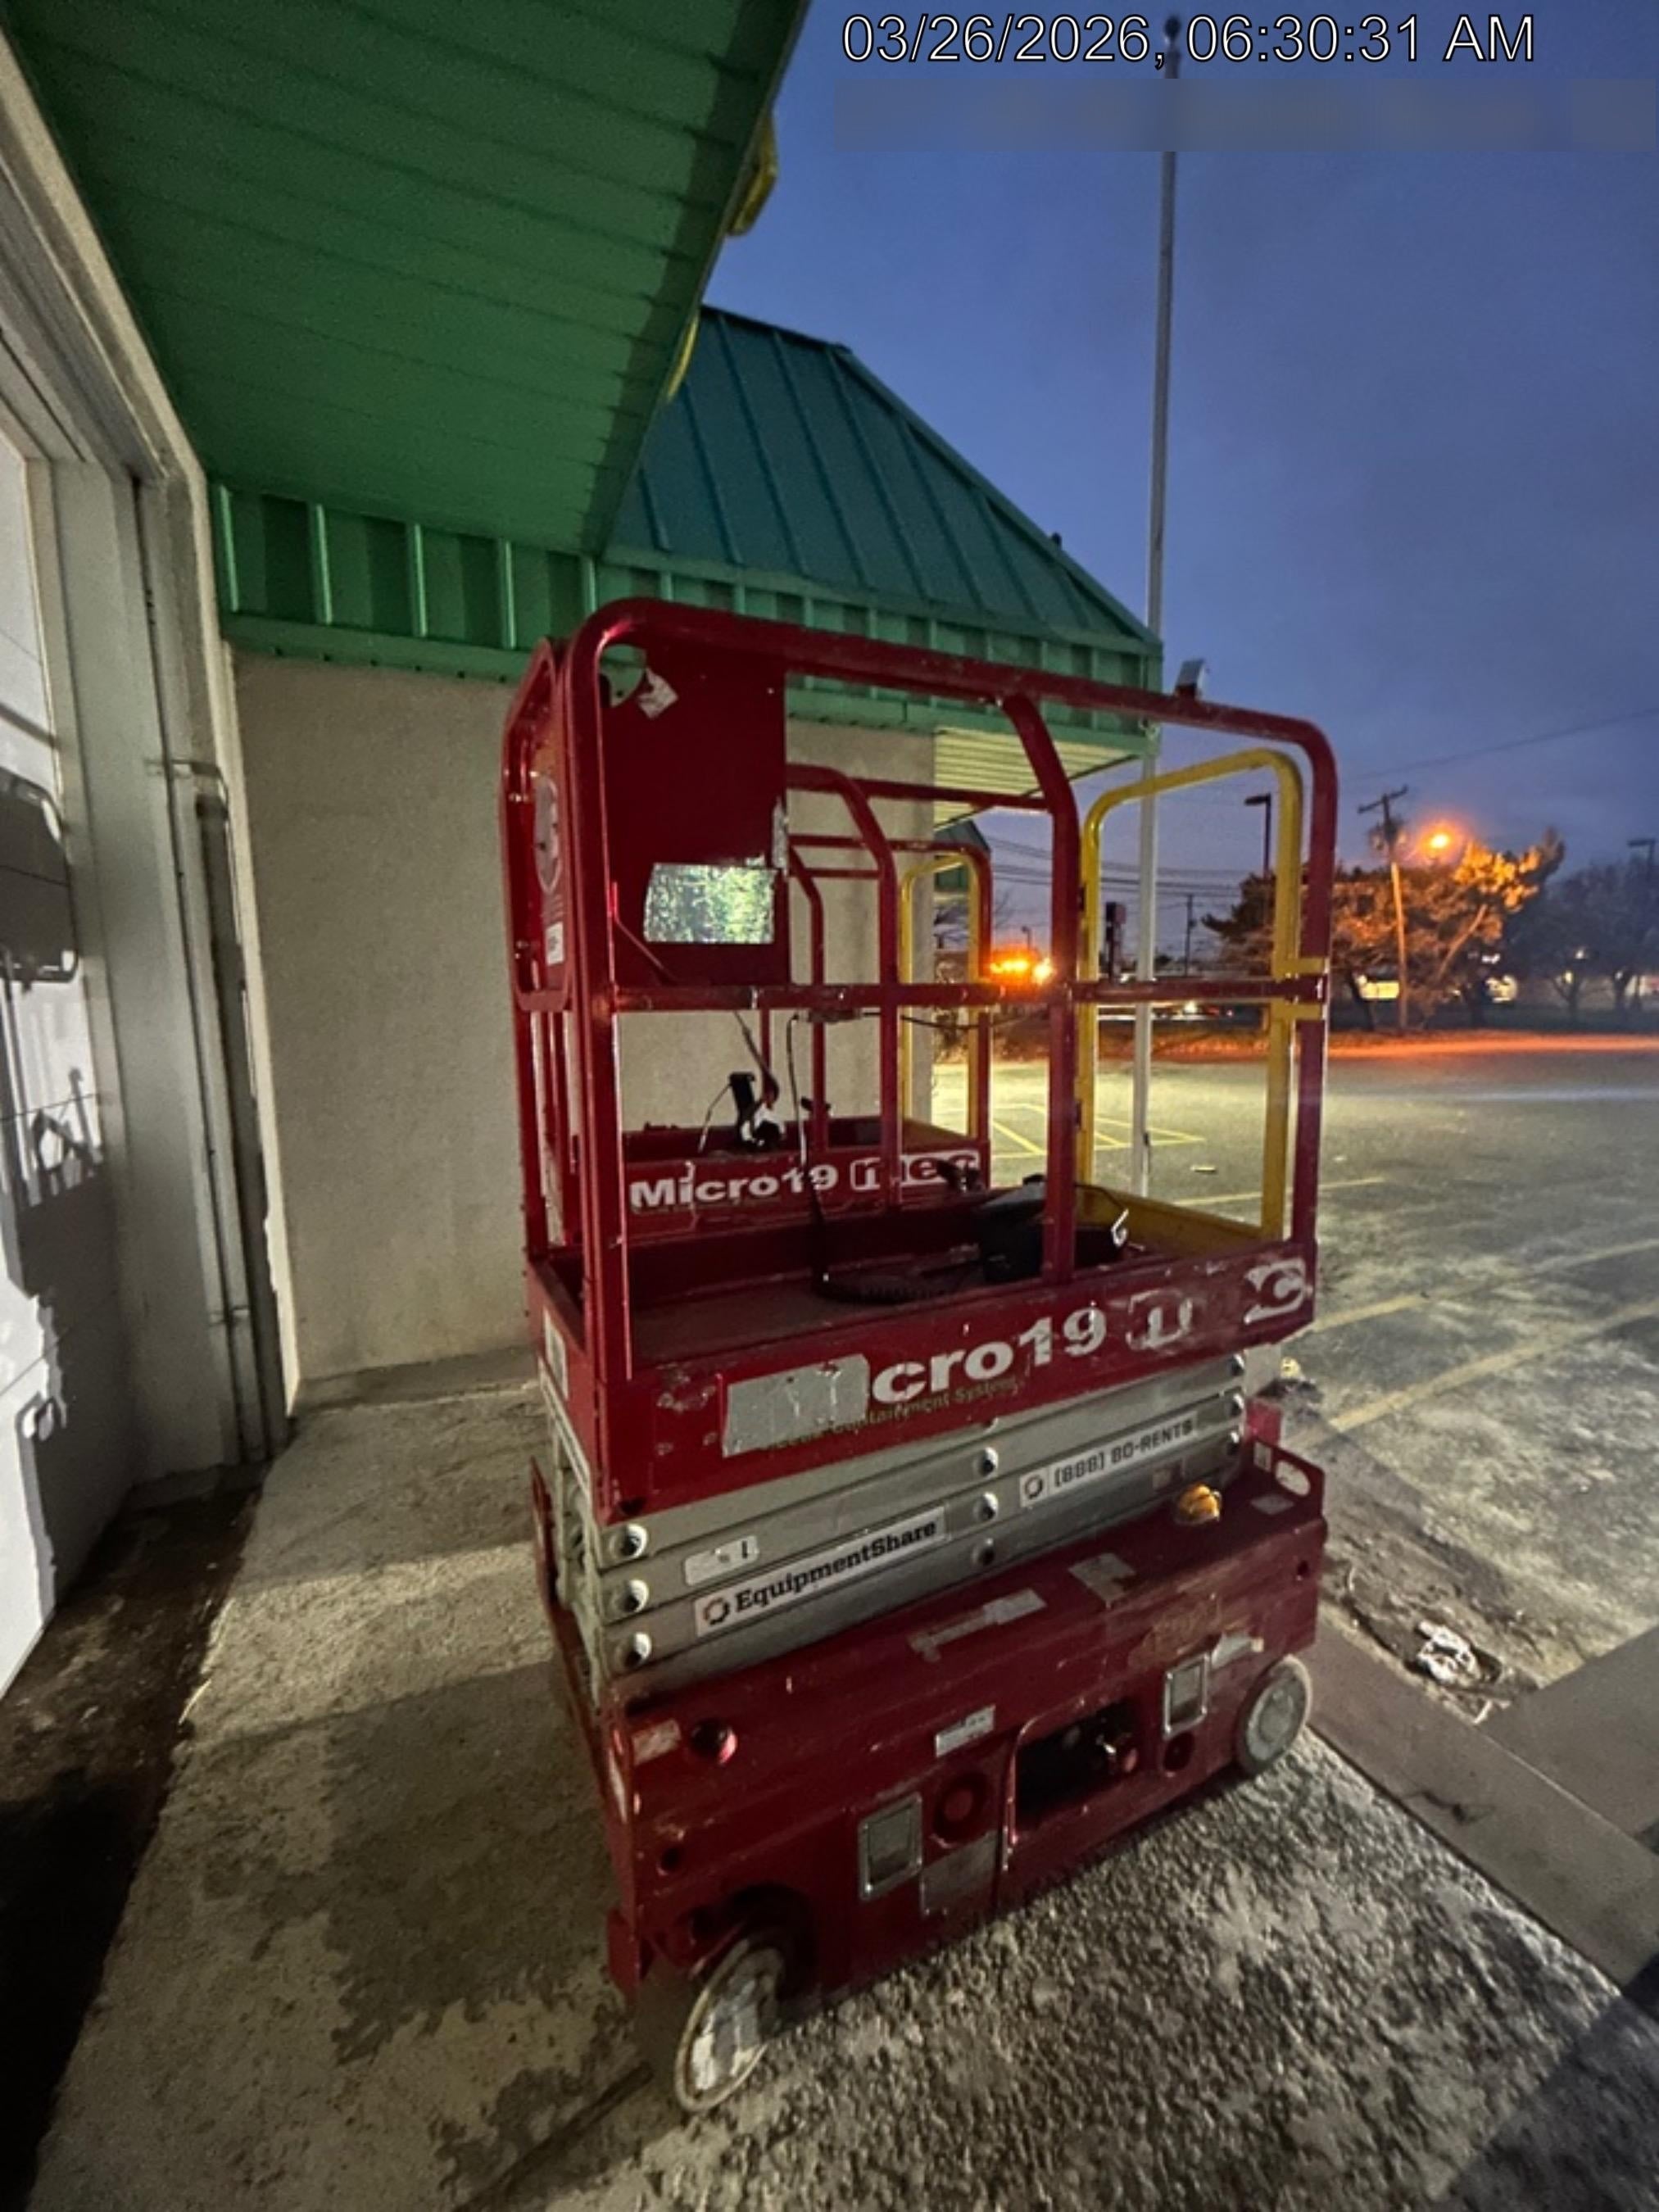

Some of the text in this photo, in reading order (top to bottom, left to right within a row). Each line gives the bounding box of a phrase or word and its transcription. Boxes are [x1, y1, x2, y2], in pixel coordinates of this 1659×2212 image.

[629, 1162, 839, 1208] Micro19
[872, 1306, 1108, 1404] cro19
[734, 1520, 937, 1613] EquipmentShare
